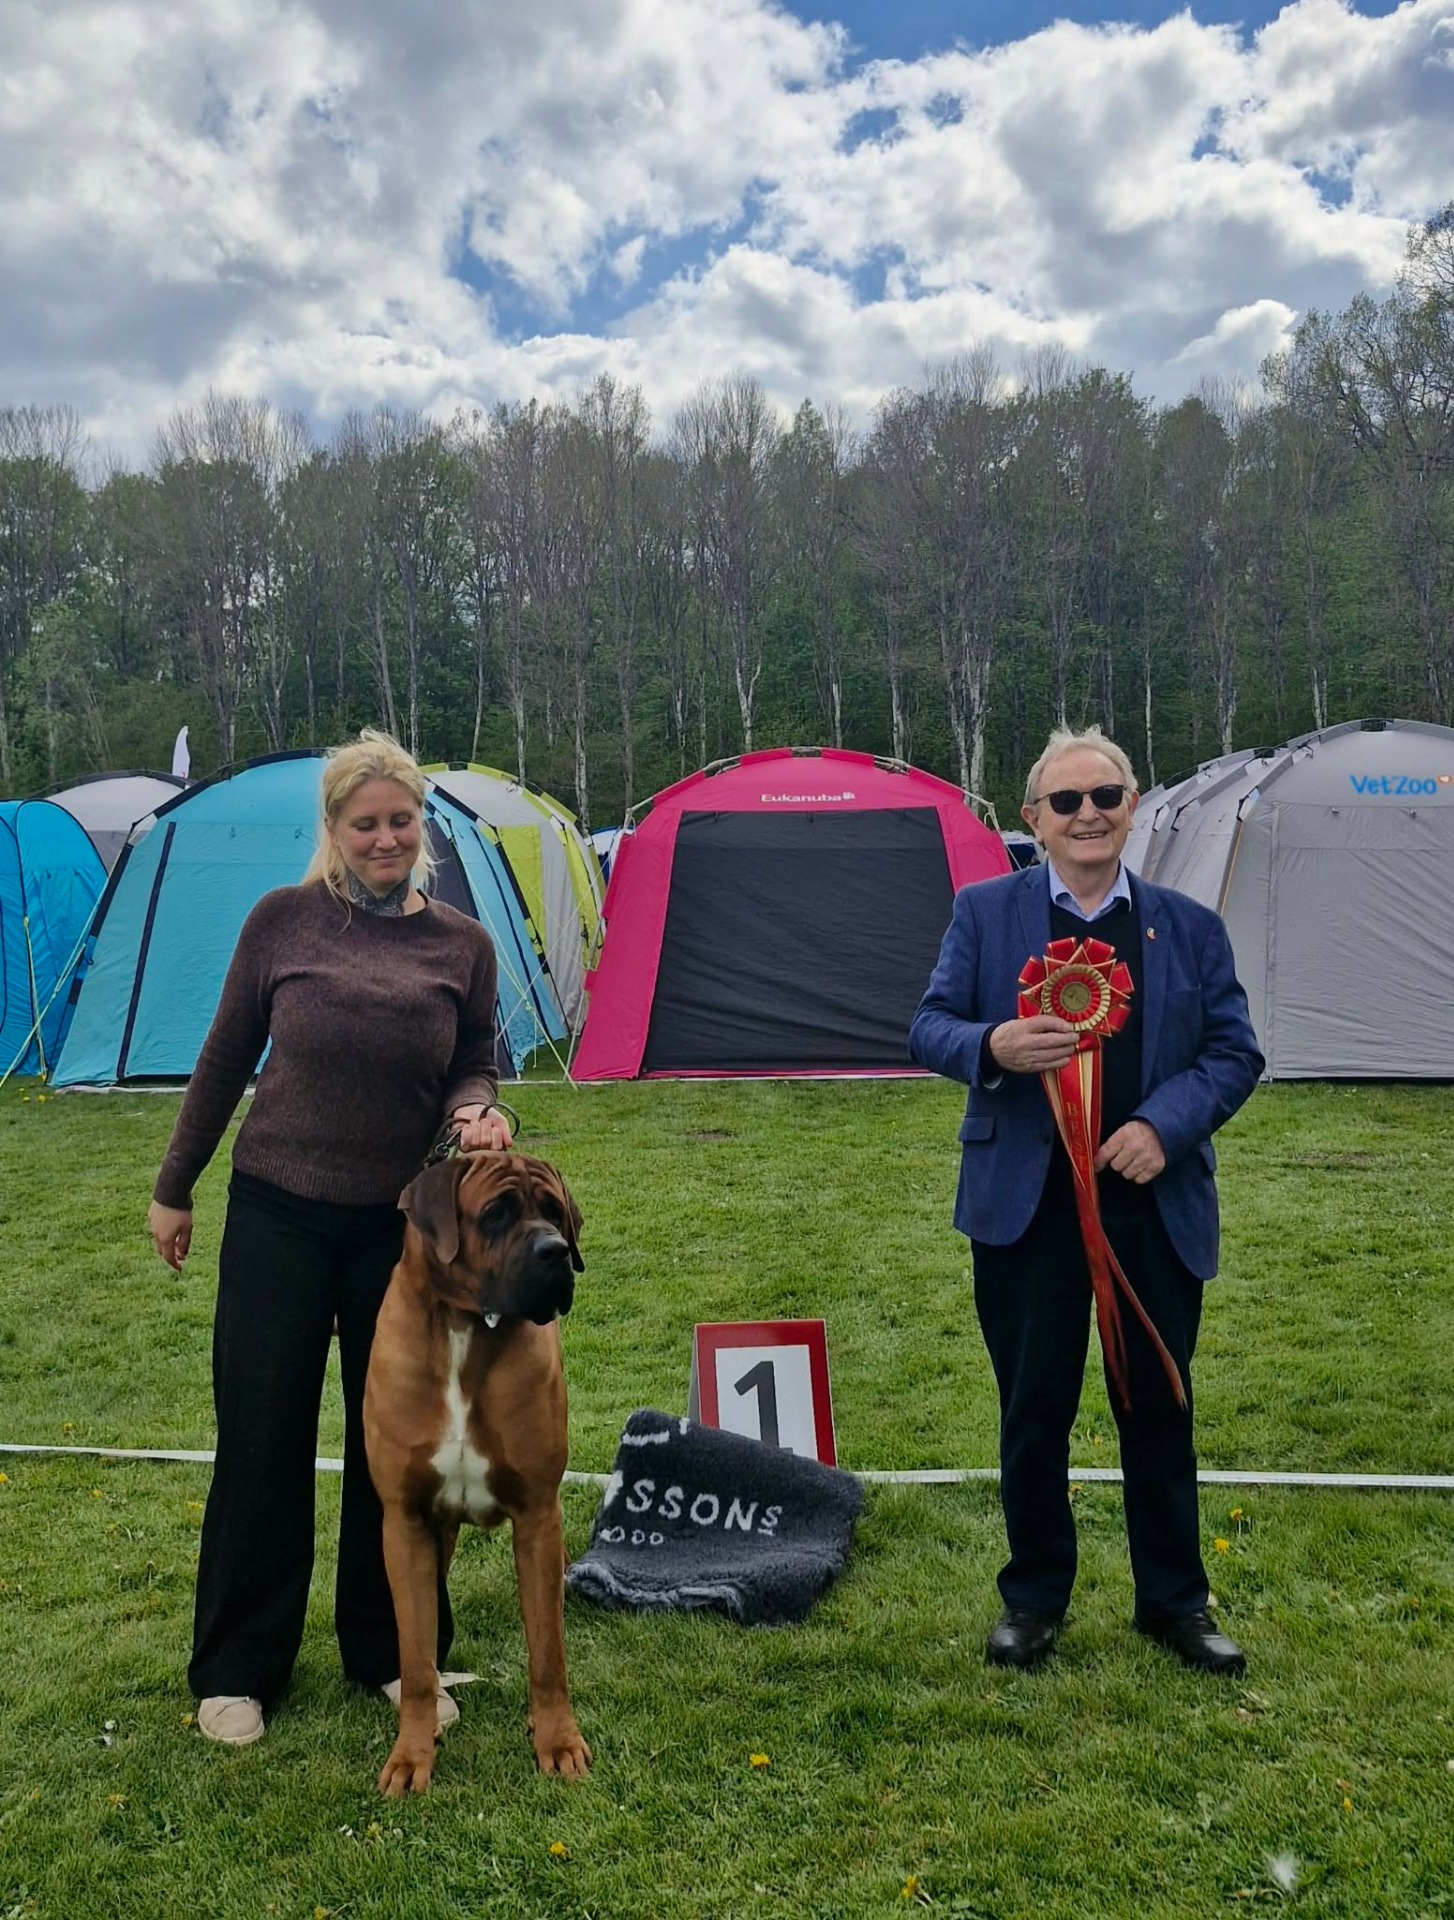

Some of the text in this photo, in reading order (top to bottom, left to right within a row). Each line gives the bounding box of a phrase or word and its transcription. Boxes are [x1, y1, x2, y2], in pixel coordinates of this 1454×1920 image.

[1349, 774, 1438, 795] VetZoo
[761, 793, 842, 802] Eukanuba
[733, 1360, 793, 1454] 1
